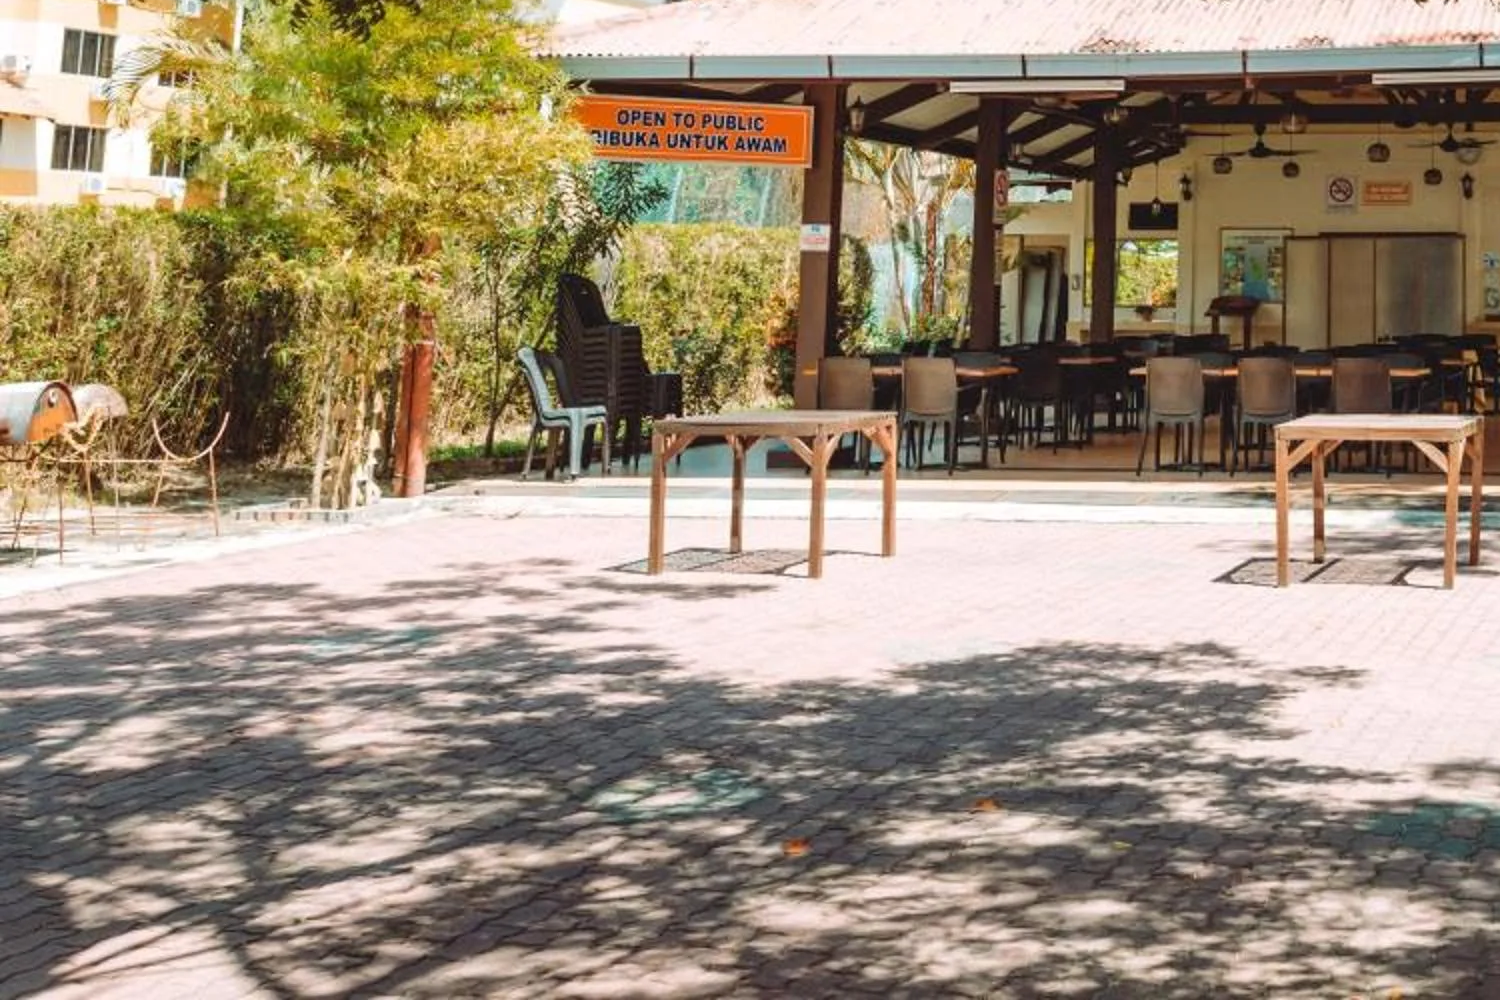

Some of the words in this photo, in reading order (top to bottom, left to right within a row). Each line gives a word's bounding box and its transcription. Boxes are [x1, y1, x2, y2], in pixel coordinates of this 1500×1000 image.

[617, 110, 666, 126] OPEN
[673, 113, 695, 128] TO
[701, 113, 764, 131] PUBLIC
[667, 133, 728, 150] UNTUK
[735, 135, 787, 153] AWAM
